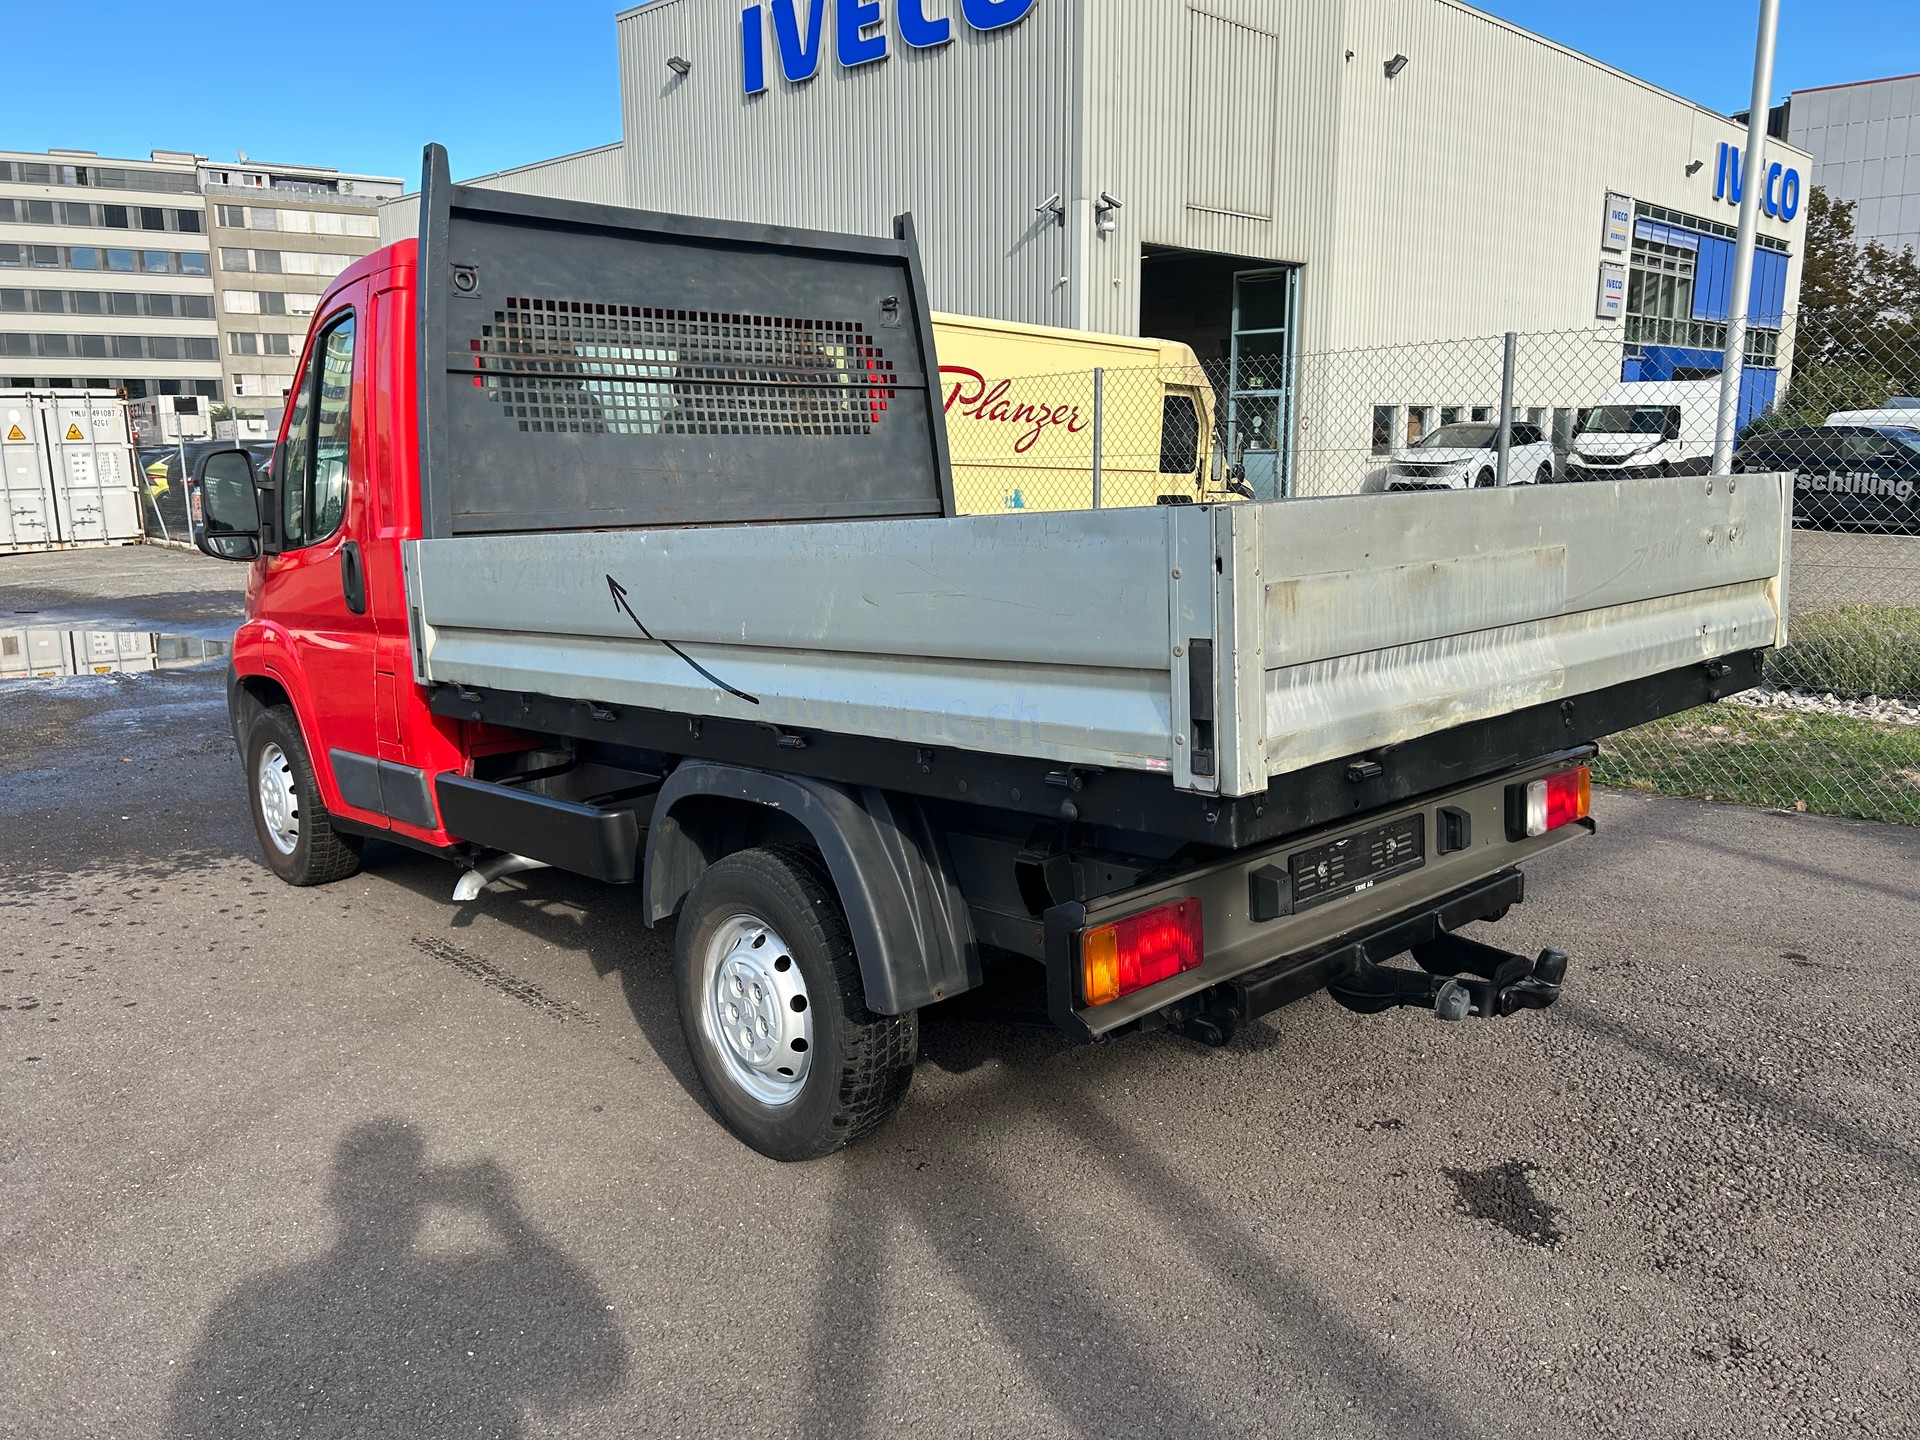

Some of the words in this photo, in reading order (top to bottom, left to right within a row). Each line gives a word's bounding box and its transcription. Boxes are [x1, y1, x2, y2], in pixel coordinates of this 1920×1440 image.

[1713, 141, 1800, 222] IVCO
[1611, 210, 1628, 222] IVECO
[1606, 279, 1623, 290] IVECO
[938, 365, 1090, 454] Planzer
